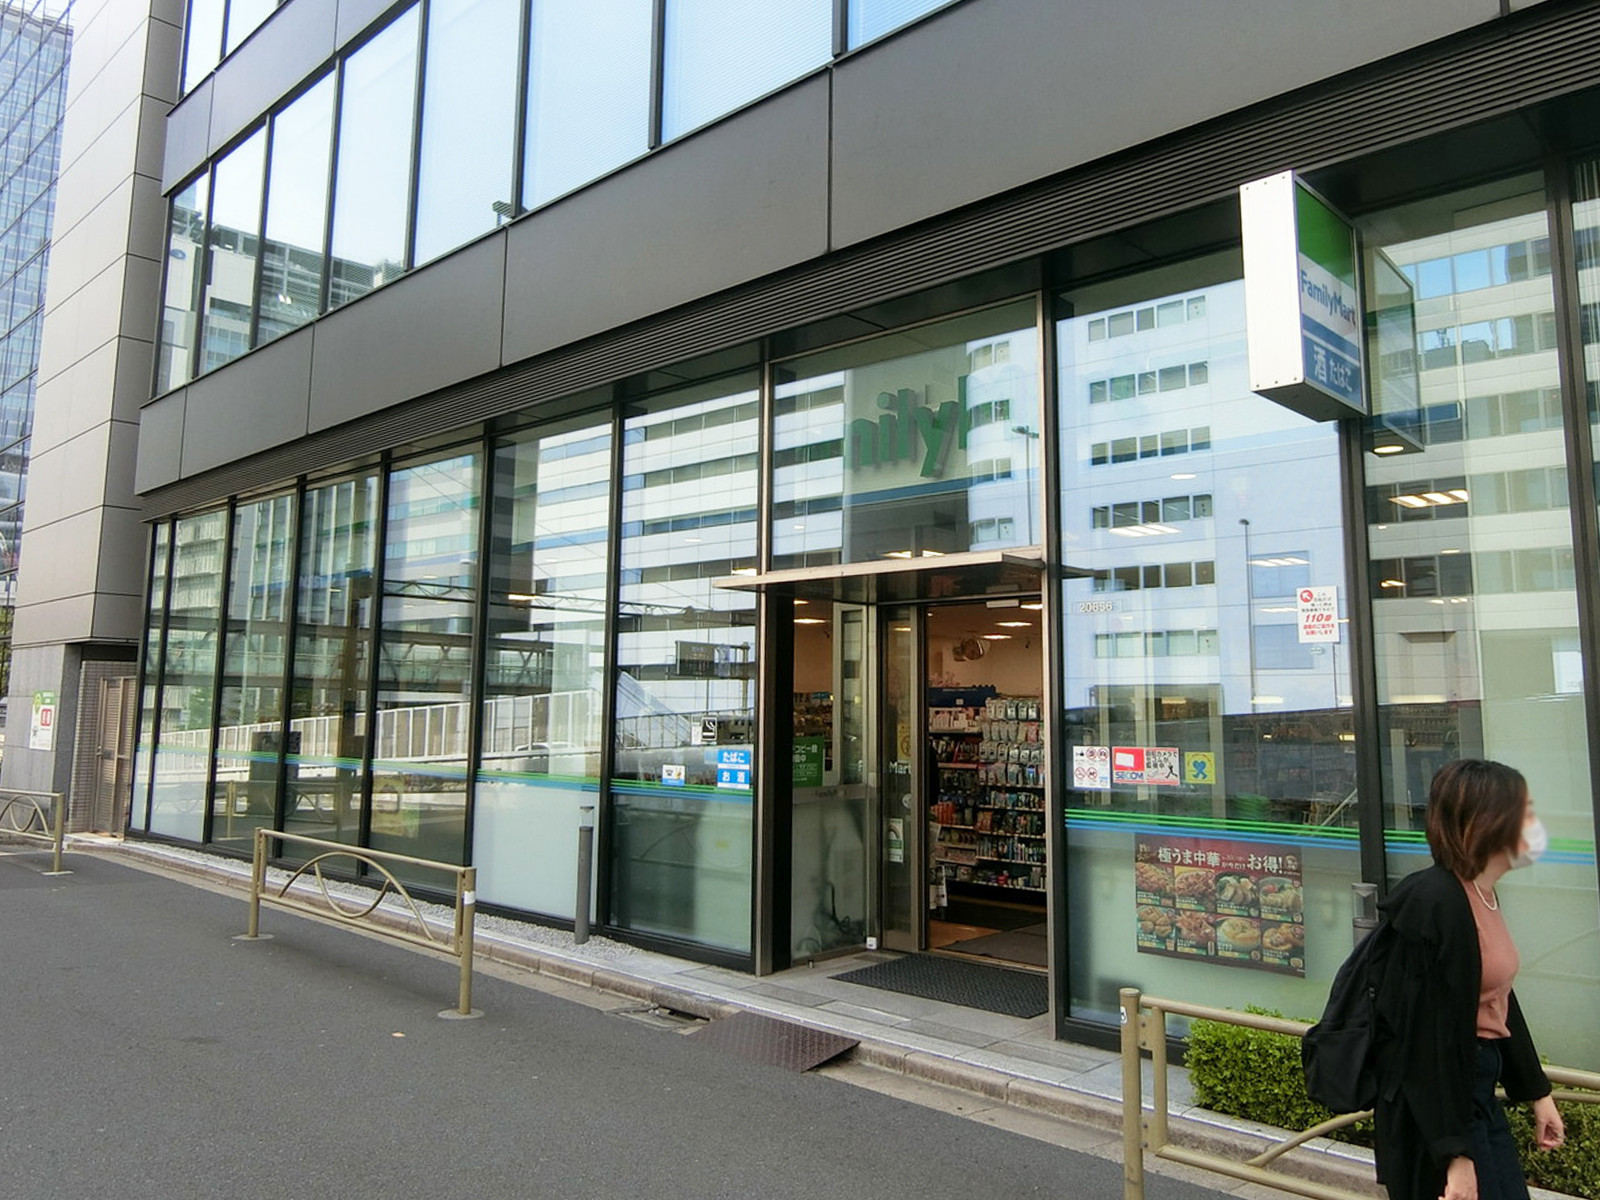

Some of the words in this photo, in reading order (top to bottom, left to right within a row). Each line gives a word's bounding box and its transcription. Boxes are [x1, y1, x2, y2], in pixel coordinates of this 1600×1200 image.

[1300, 269, 1356, 326] FamilyMart
[1313, 345, 1327, 384] 酒
[1329, 357, 1353, 392] たばこ
[722, 751, 746, 764] たばこ
[889, 761, 912, 775] Mart
[1115, 771, 1144, 780] SECOM
